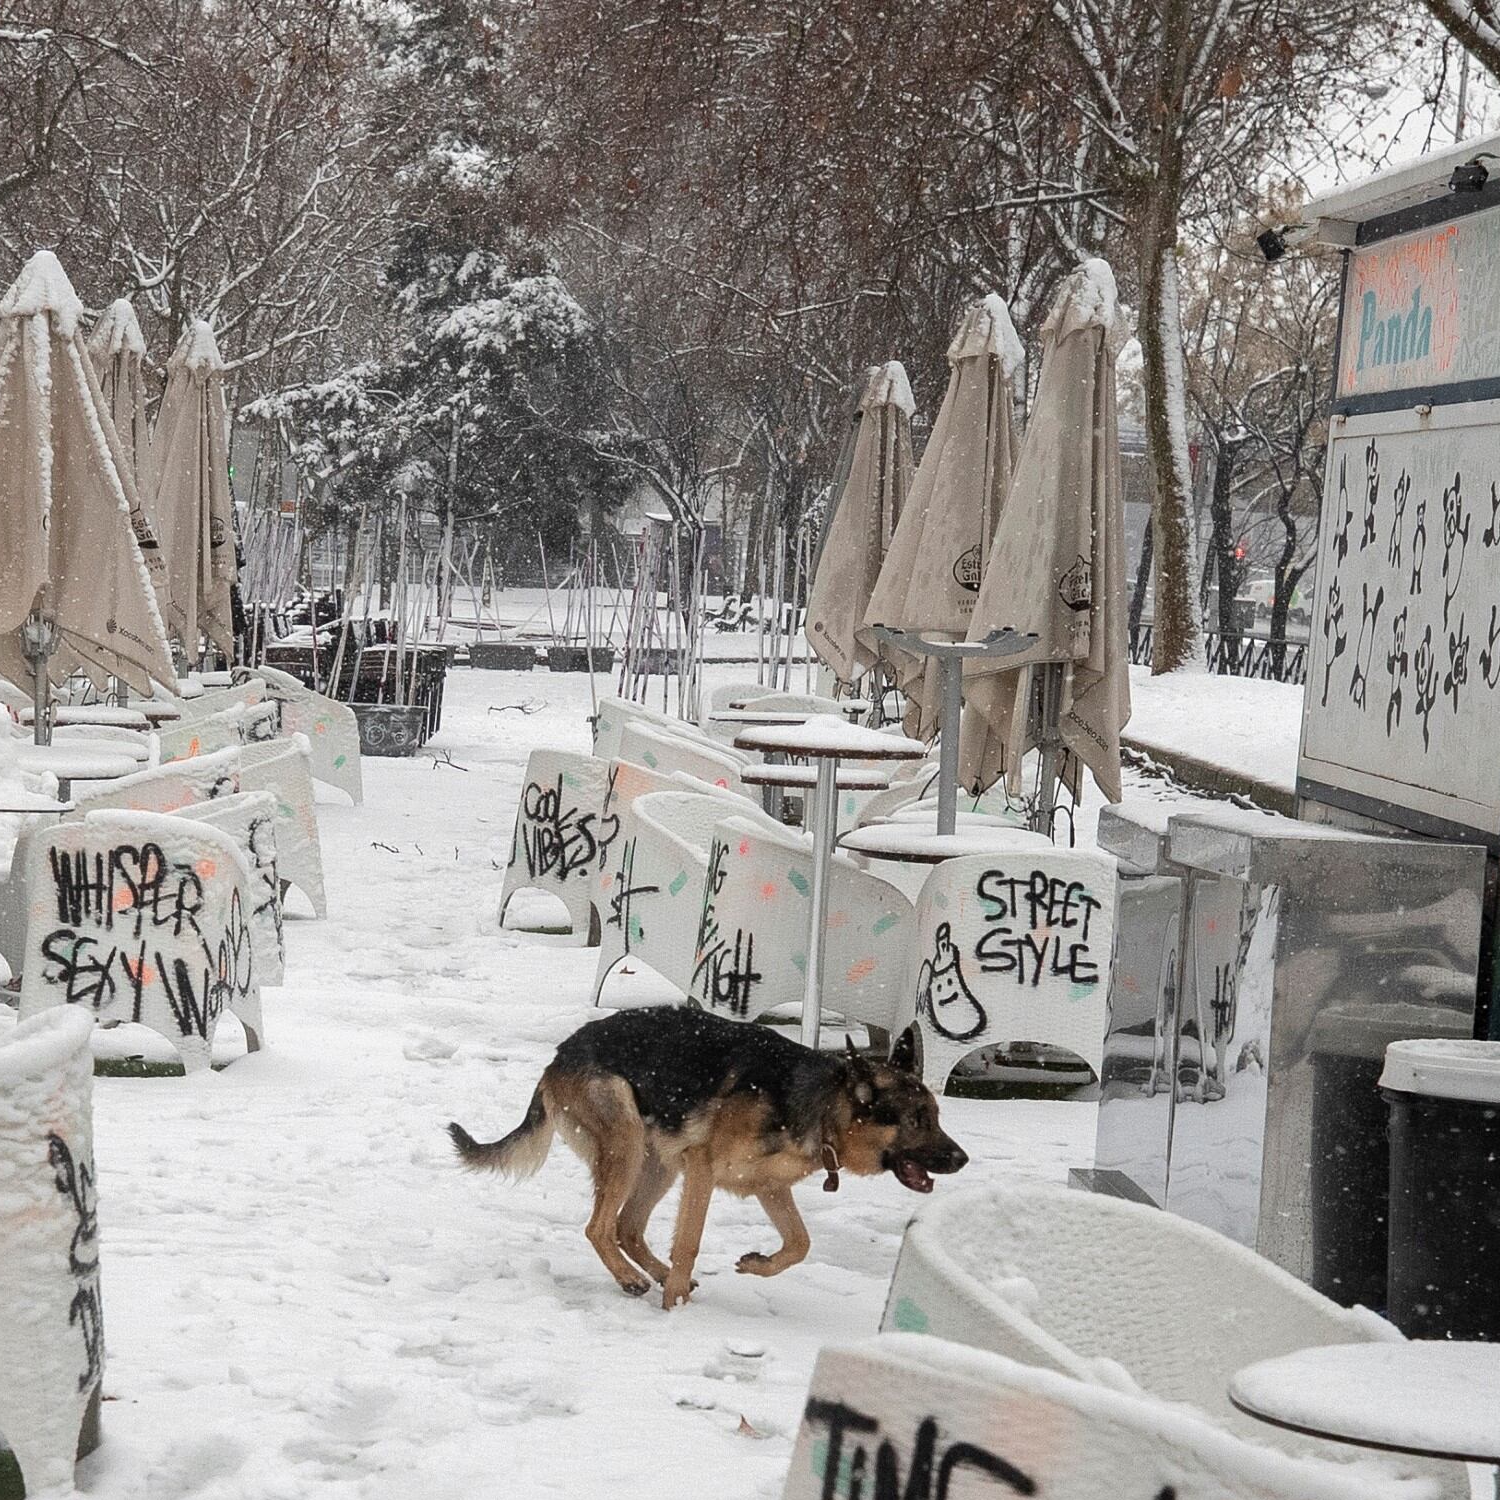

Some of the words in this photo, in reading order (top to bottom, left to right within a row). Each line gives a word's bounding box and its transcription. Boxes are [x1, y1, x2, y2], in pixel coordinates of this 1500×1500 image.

[1355, 284, 1434, 373] Panda
[49, 842, 211, 958] WHISPER
[977, 870, 1102, 943] STREET
[41, 929, 147, 1023] SEXY
[974, 927, 1100, 988] STYLE
